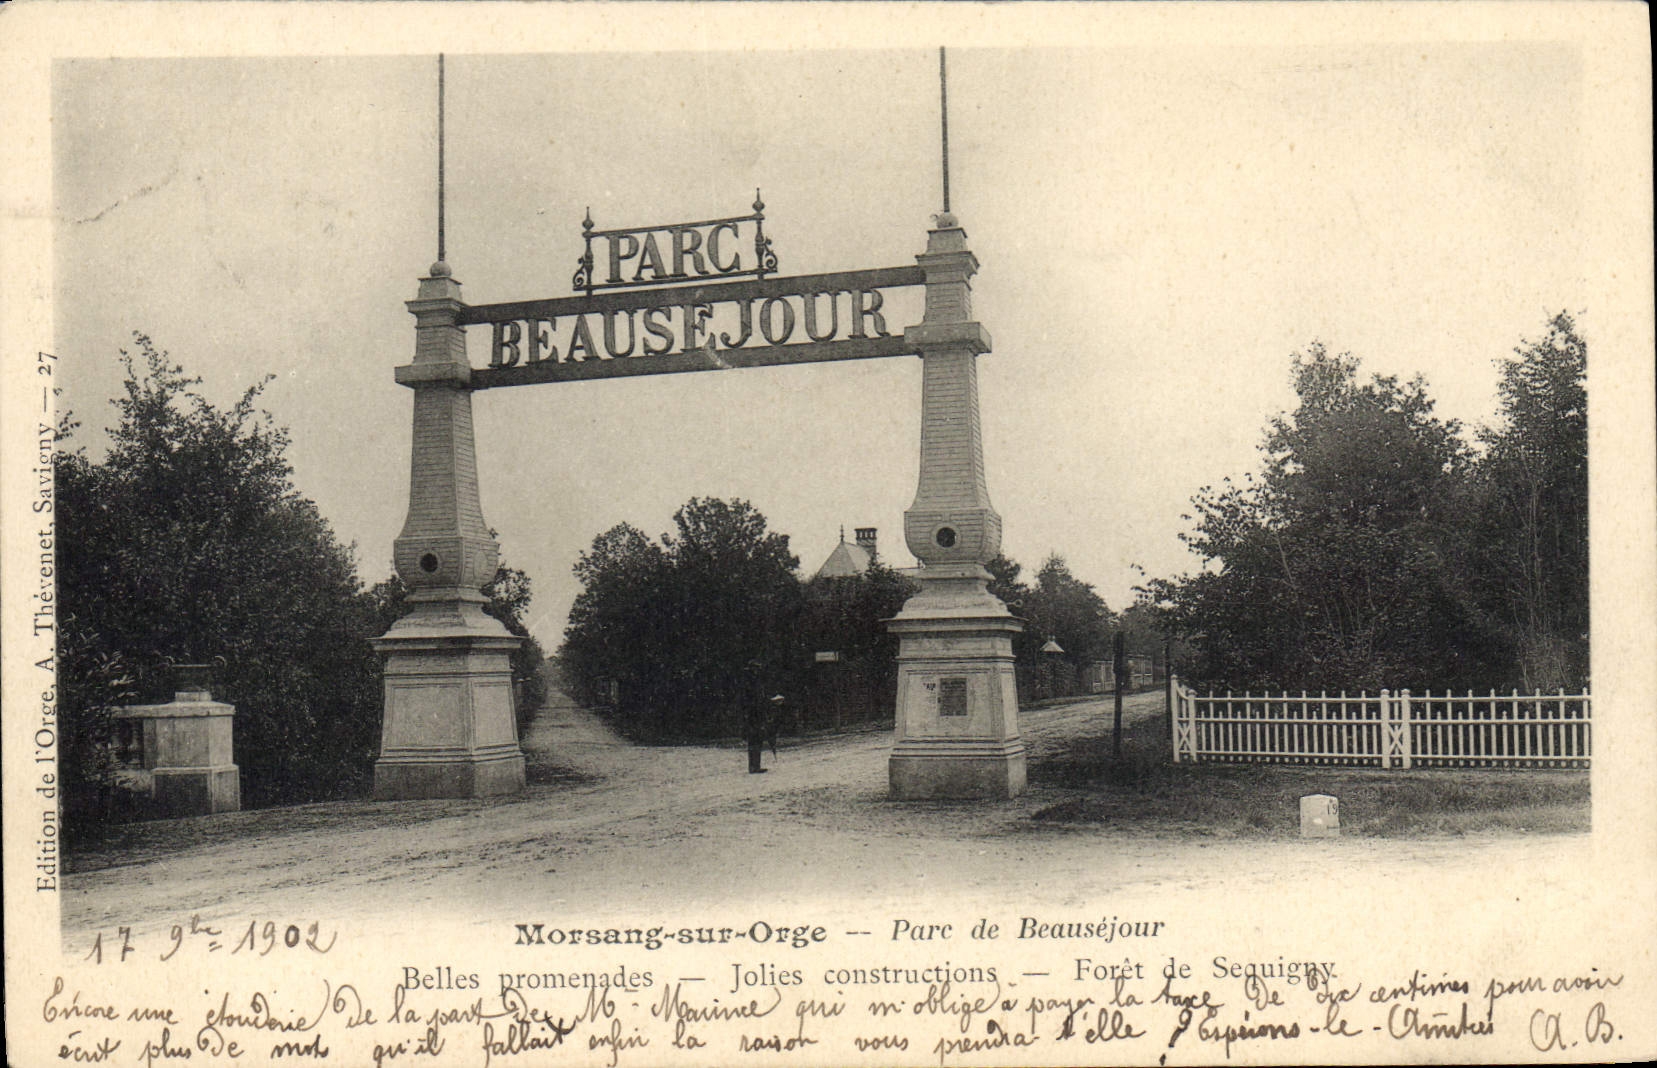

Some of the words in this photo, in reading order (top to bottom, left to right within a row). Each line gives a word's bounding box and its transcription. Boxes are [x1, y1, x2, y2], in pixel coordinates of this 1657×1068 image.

[606, 223, 741, 282] PARC
[489, 288, 888, 369] BEAUSEJOUR
[84, 926, 135, 965] 17
[231, 920, 338, 957] 1902
[387, 983, 422, 1024] la
[1109, 974, 1144, 1008] la
[672, 1018, 706, 1049] la
